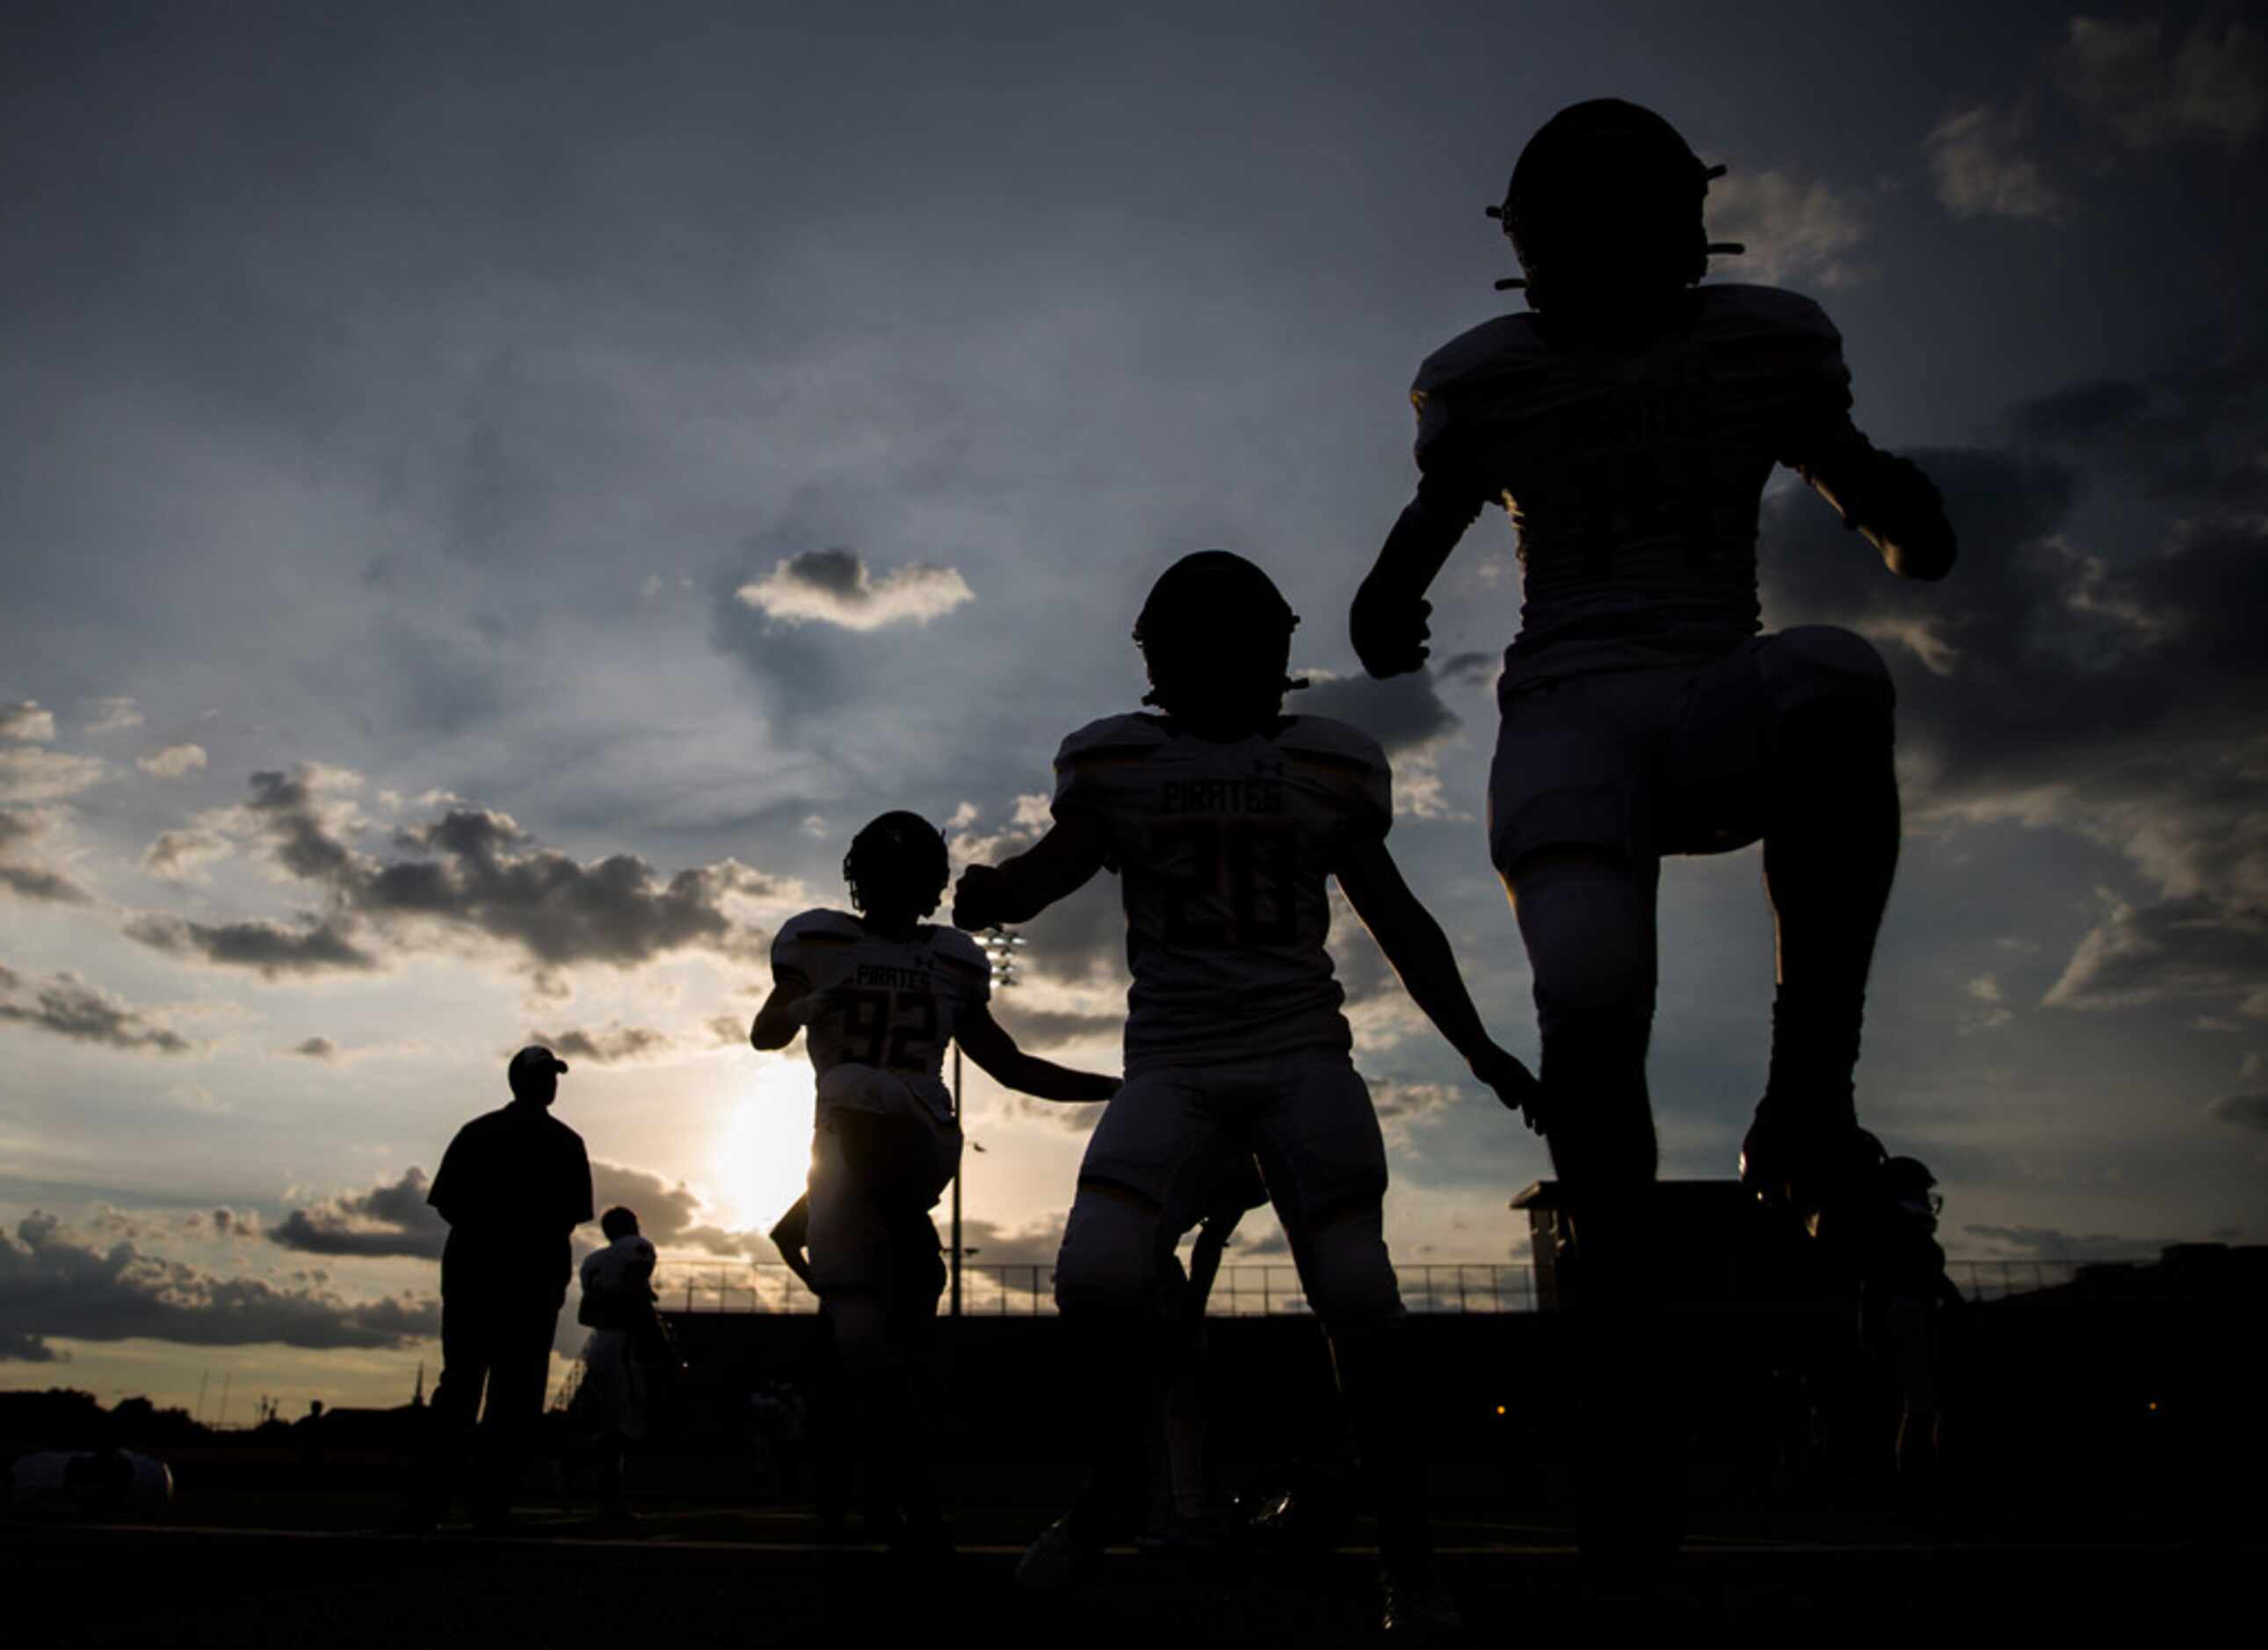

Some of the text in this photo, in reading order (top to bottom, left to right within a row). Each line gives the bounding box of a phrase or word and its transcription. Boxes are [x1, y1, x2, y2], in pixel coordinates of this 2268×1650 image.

[1163, 778, 1283, 814] PIRATES
[857, 964, 931, 988] PIRATES
[840, 990, 938, 1071] 92
